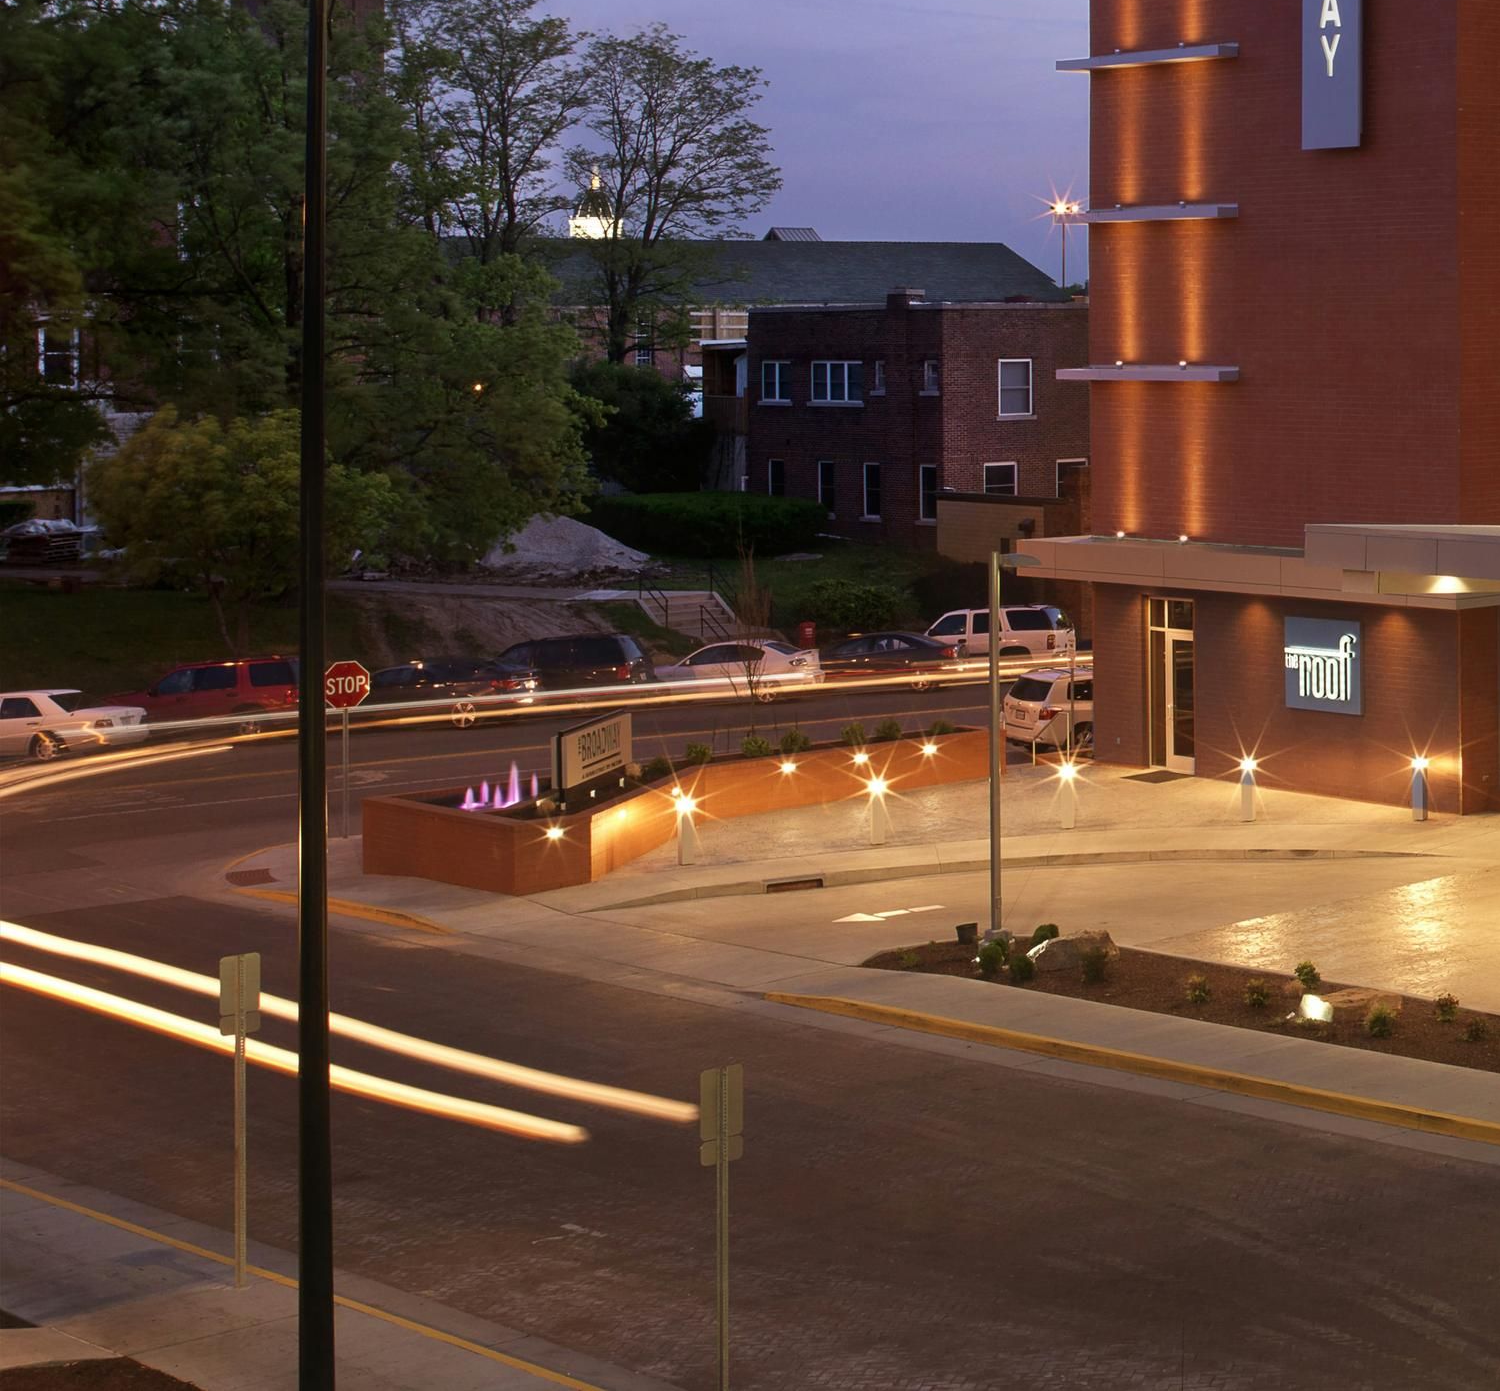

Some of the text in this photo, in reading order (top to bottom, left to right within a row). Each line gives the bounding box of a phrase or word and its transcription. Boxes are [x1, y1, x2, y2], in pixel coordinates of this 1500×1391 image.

[326, 675, 366, 695] STOP
[1285, 634, 1356, 700] the roof
[581, 721, 622, 761] BROADWAY
